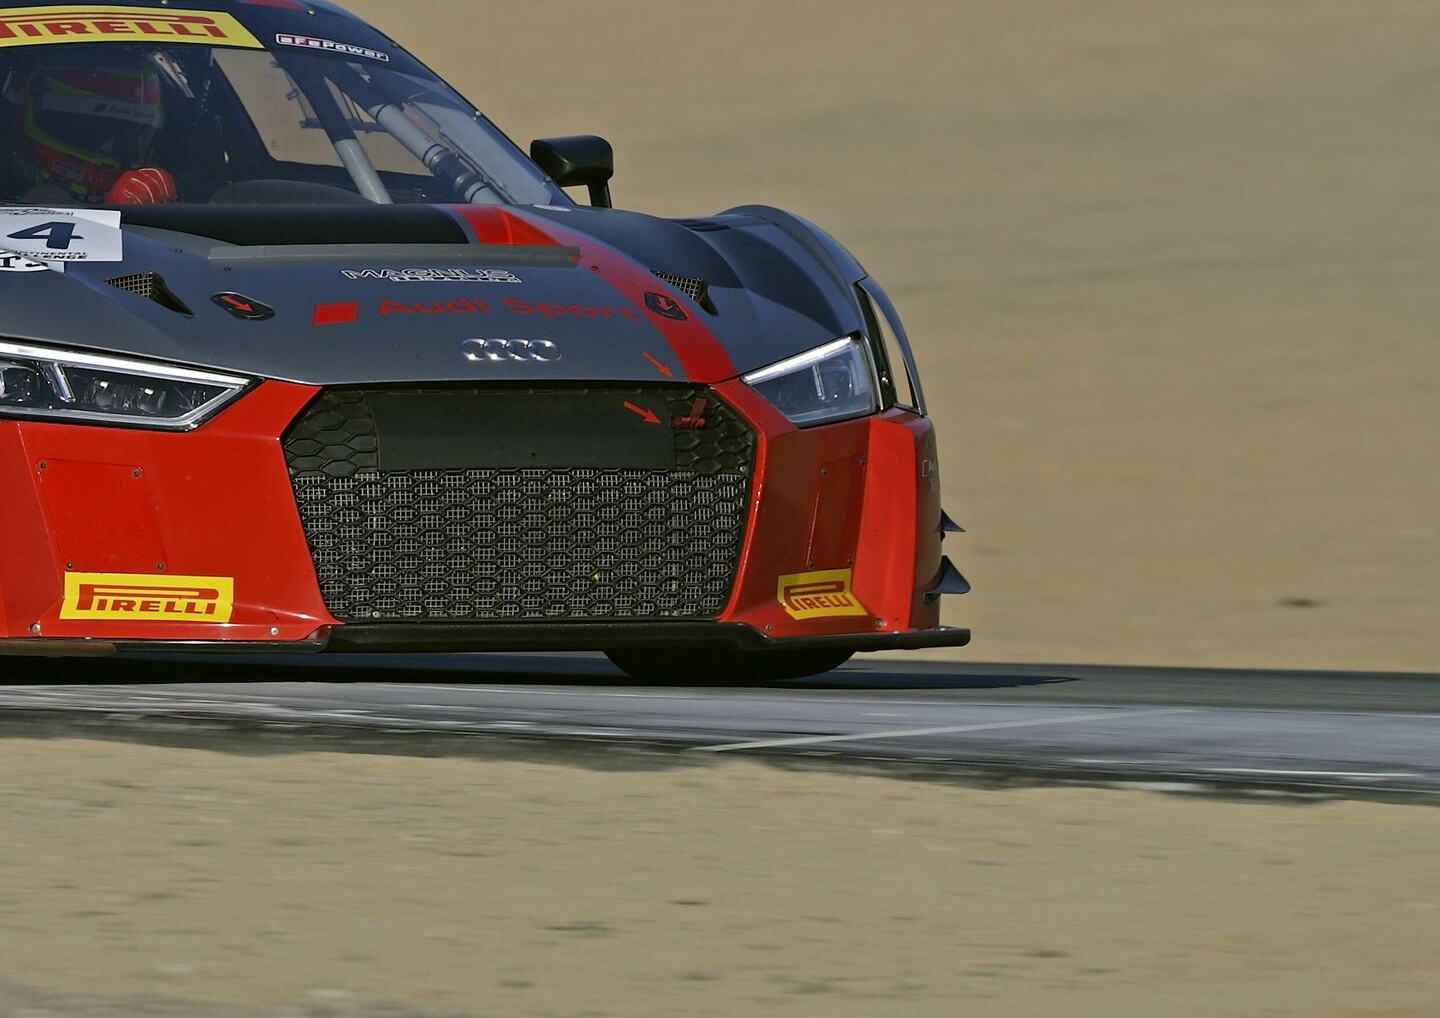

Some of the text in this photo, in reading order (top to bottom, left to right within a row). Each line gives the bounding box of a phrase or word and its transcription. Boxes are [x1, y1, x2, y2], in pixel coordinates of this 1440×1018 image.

[379, 298, 647, 322] Audi Sport
[76, 583, 220, 615] PIRELLI
[783, 580, 854, 612] PIRELLI
